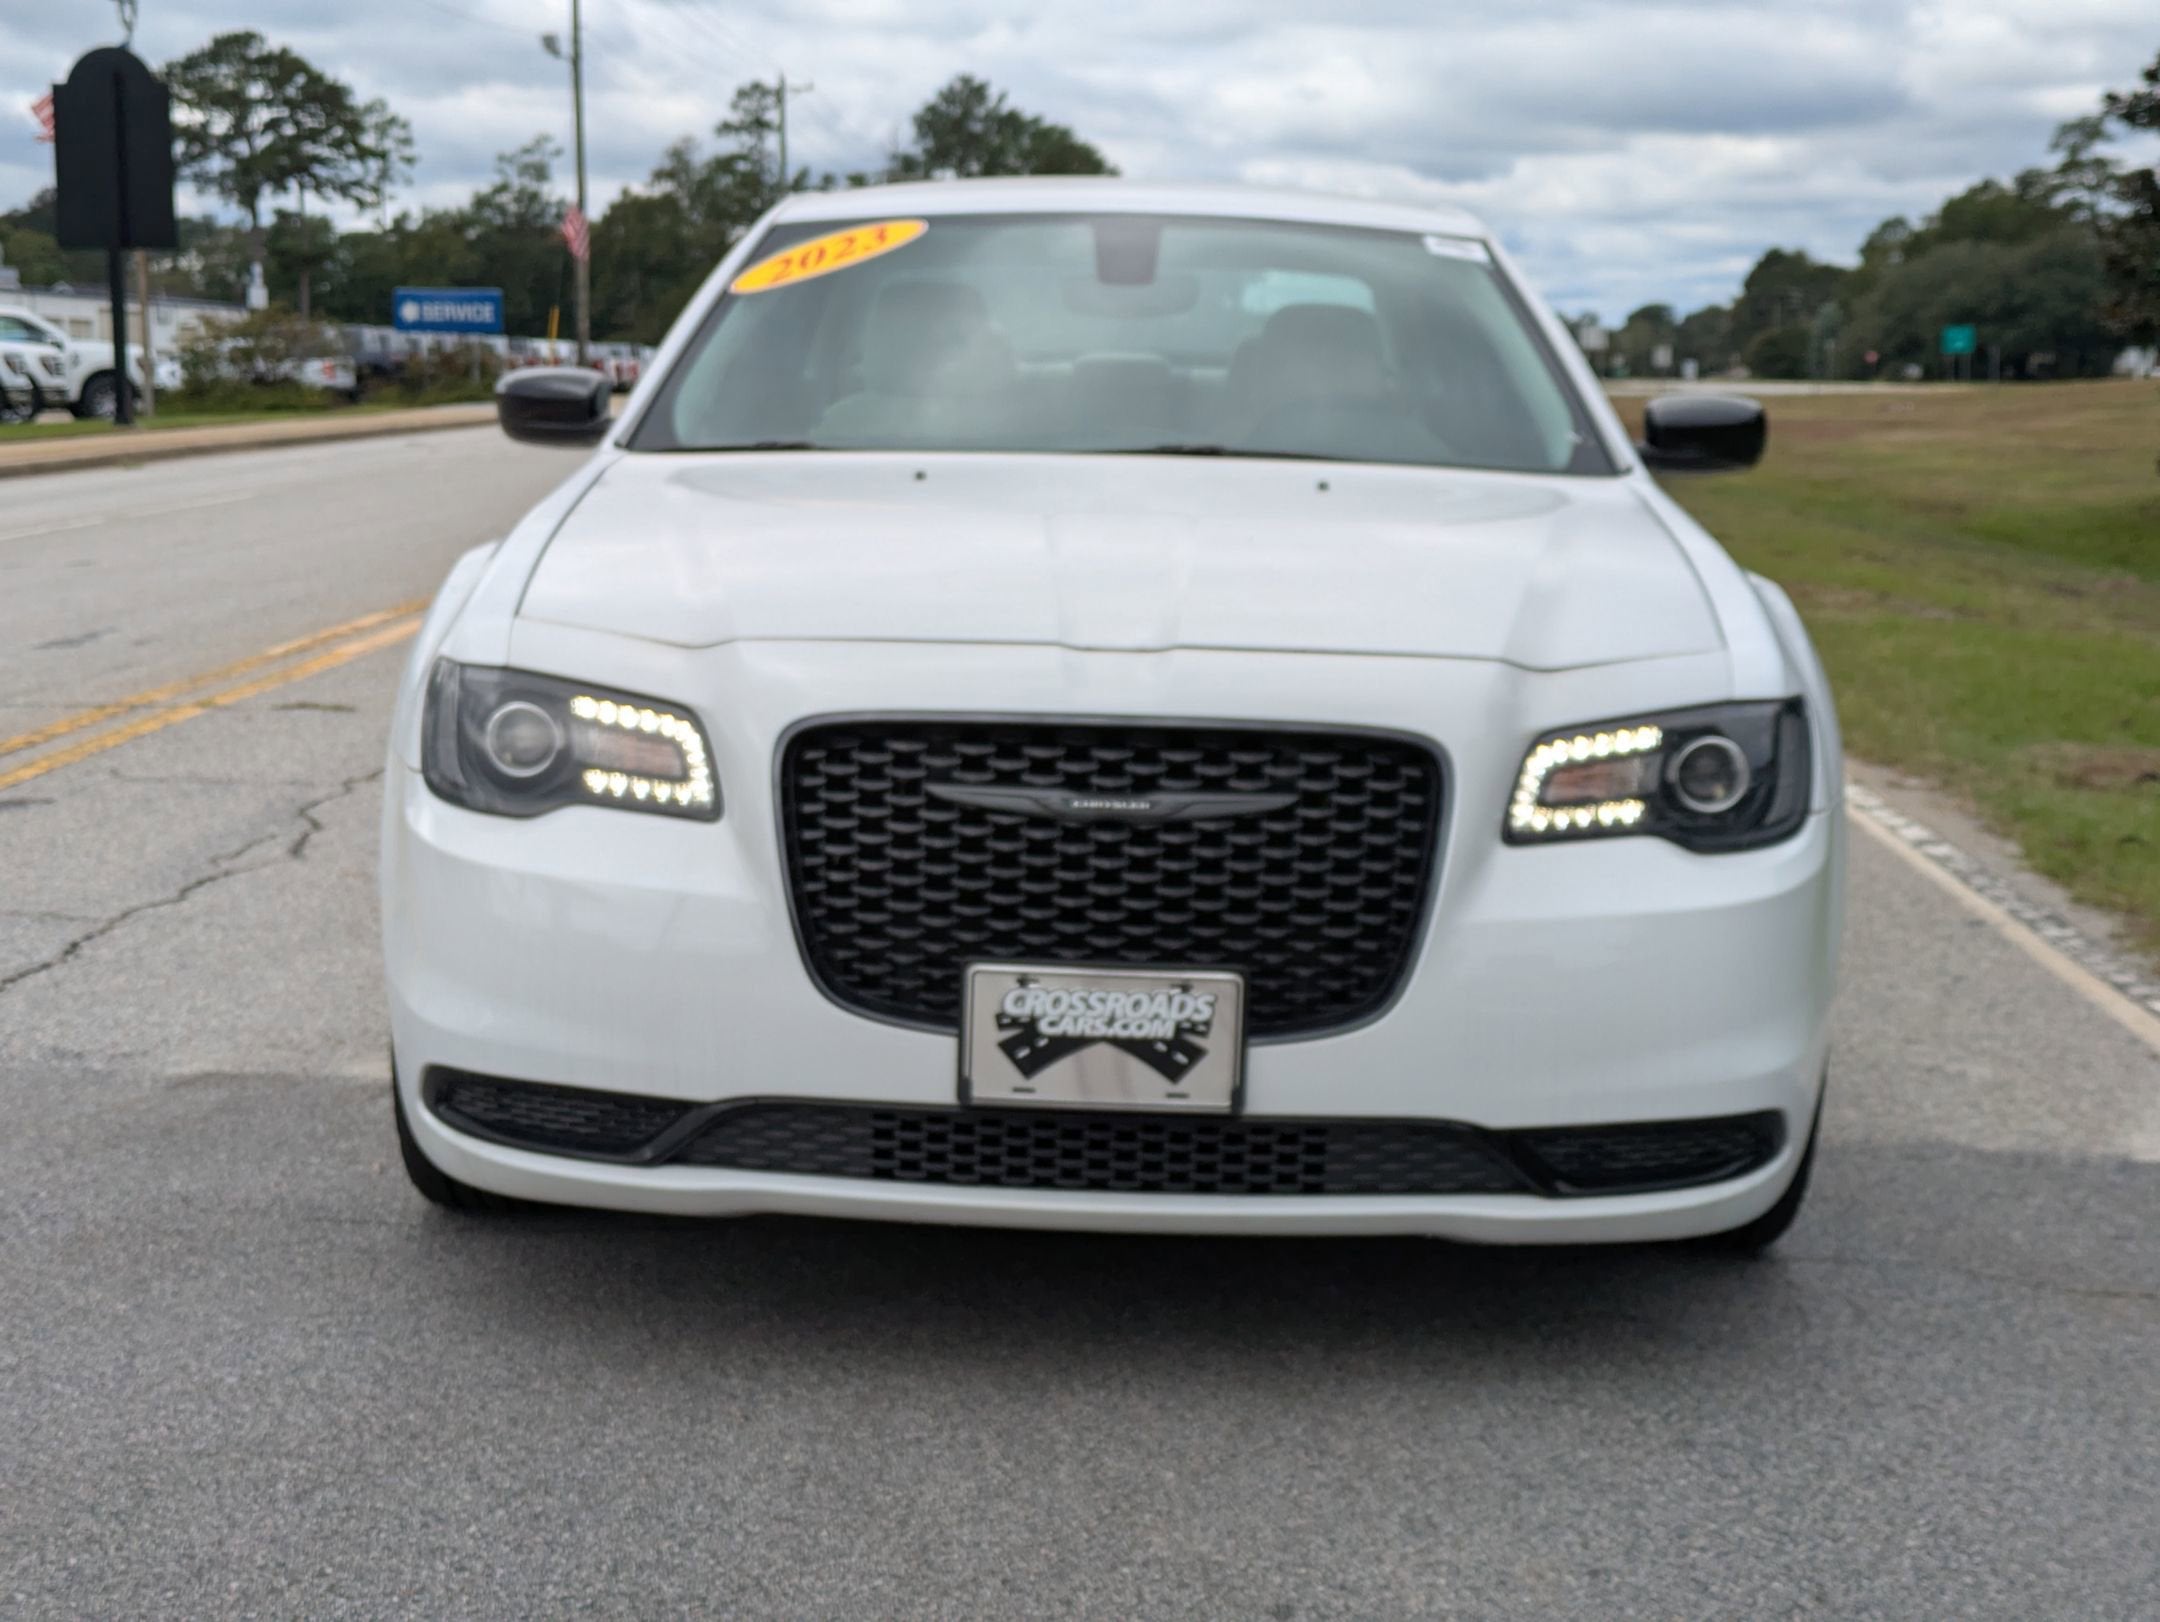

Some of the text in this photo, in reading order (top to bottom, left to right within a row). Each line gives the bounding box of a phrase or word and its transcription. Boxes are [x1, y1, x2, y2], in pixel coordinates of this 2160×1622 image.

[770, 225, 888, 283] 2023
[421, 302, 495, 322] SERVICE
[1003, 988, 1215, 1021] CROSSROADS
[1038, 1017, 1176, 1039] CARS.COM
